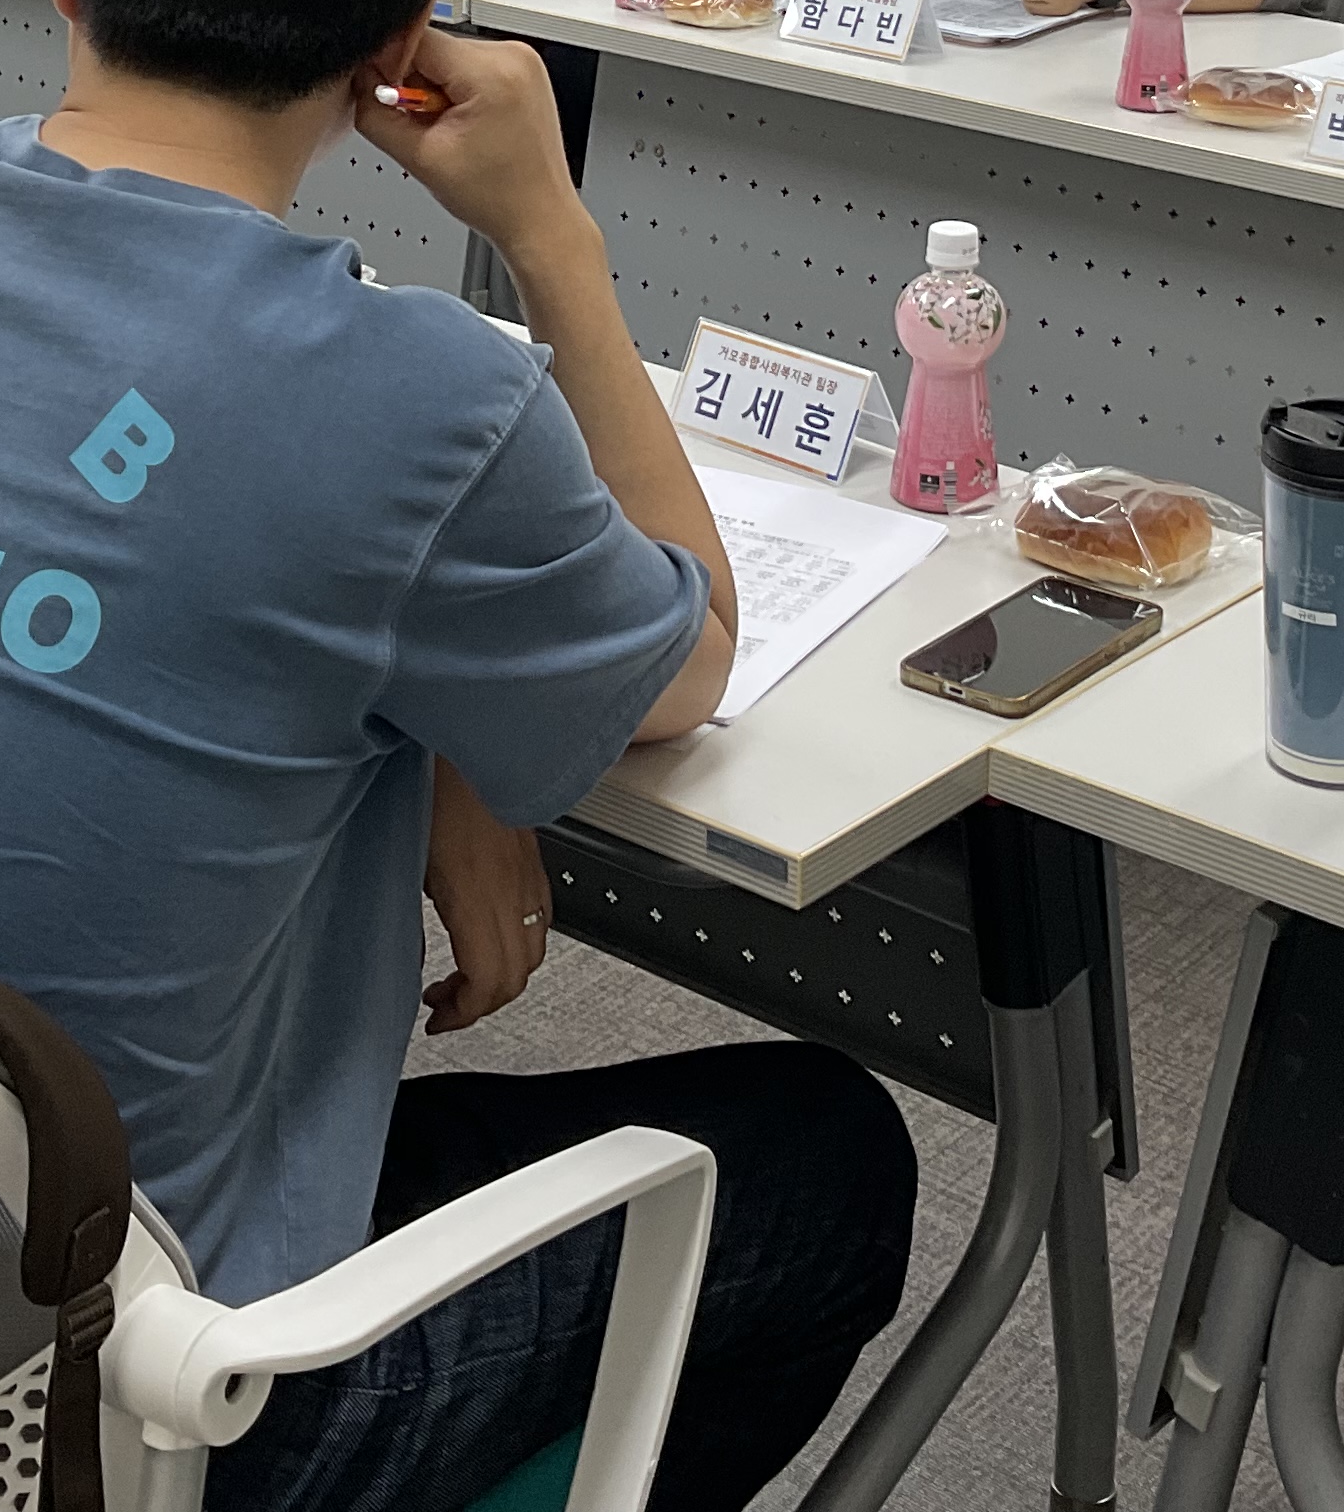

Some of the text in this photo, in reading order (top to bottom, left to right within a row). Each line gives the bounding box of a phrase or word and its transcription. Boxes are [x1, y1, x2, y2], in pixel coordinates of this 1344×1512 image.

[718, 345, 838, 395] 거모종합사회복지관 팀장
[695, 368, 836, 456] 김세훈
